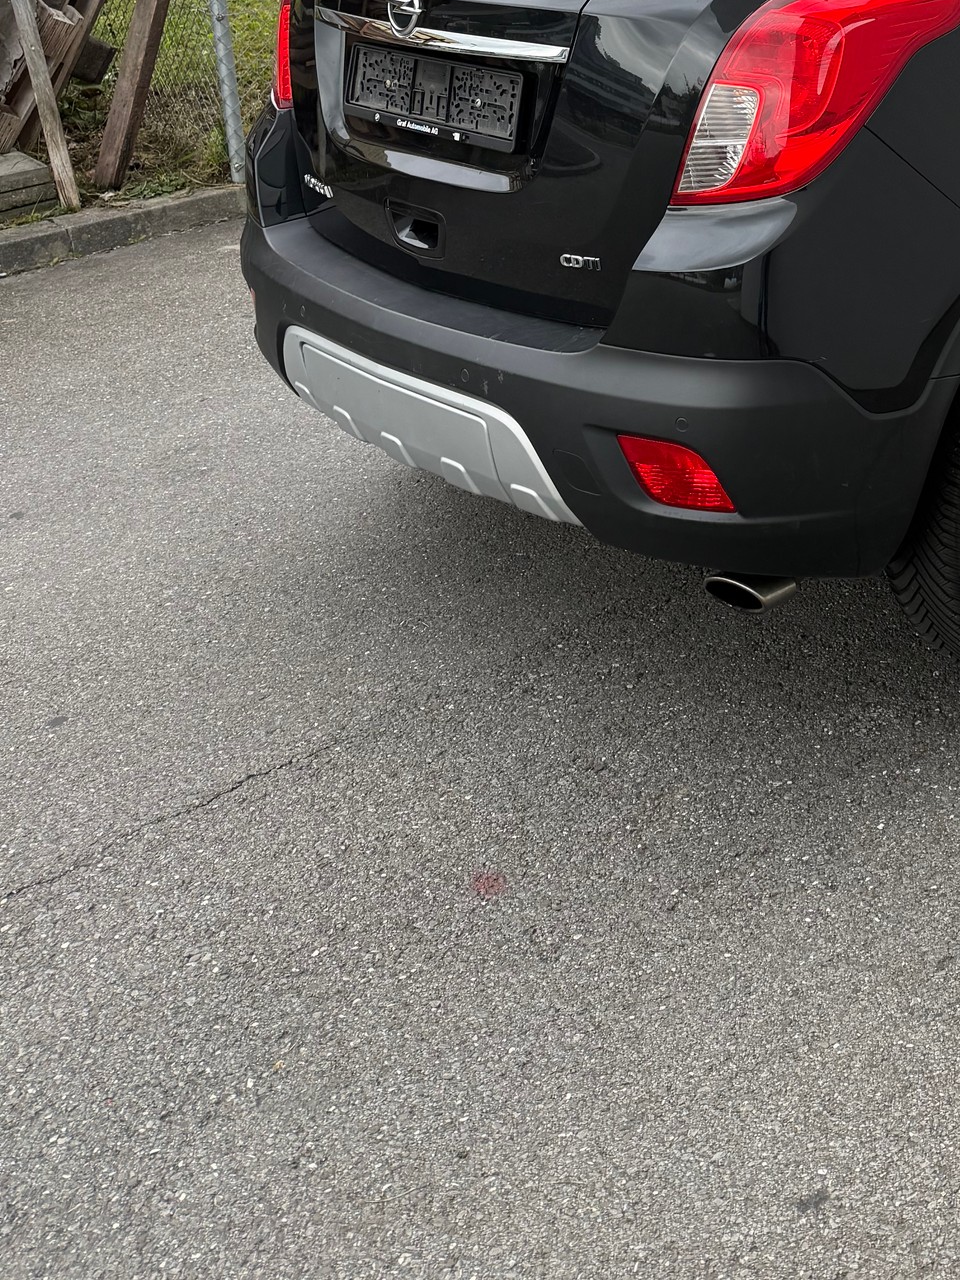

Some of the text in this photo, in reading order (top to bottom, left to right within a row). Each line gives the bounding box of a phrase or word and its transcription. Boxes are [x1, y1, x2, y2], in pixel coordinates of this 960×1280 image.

[396, 118, 439, 135] Graf Automobile AG
